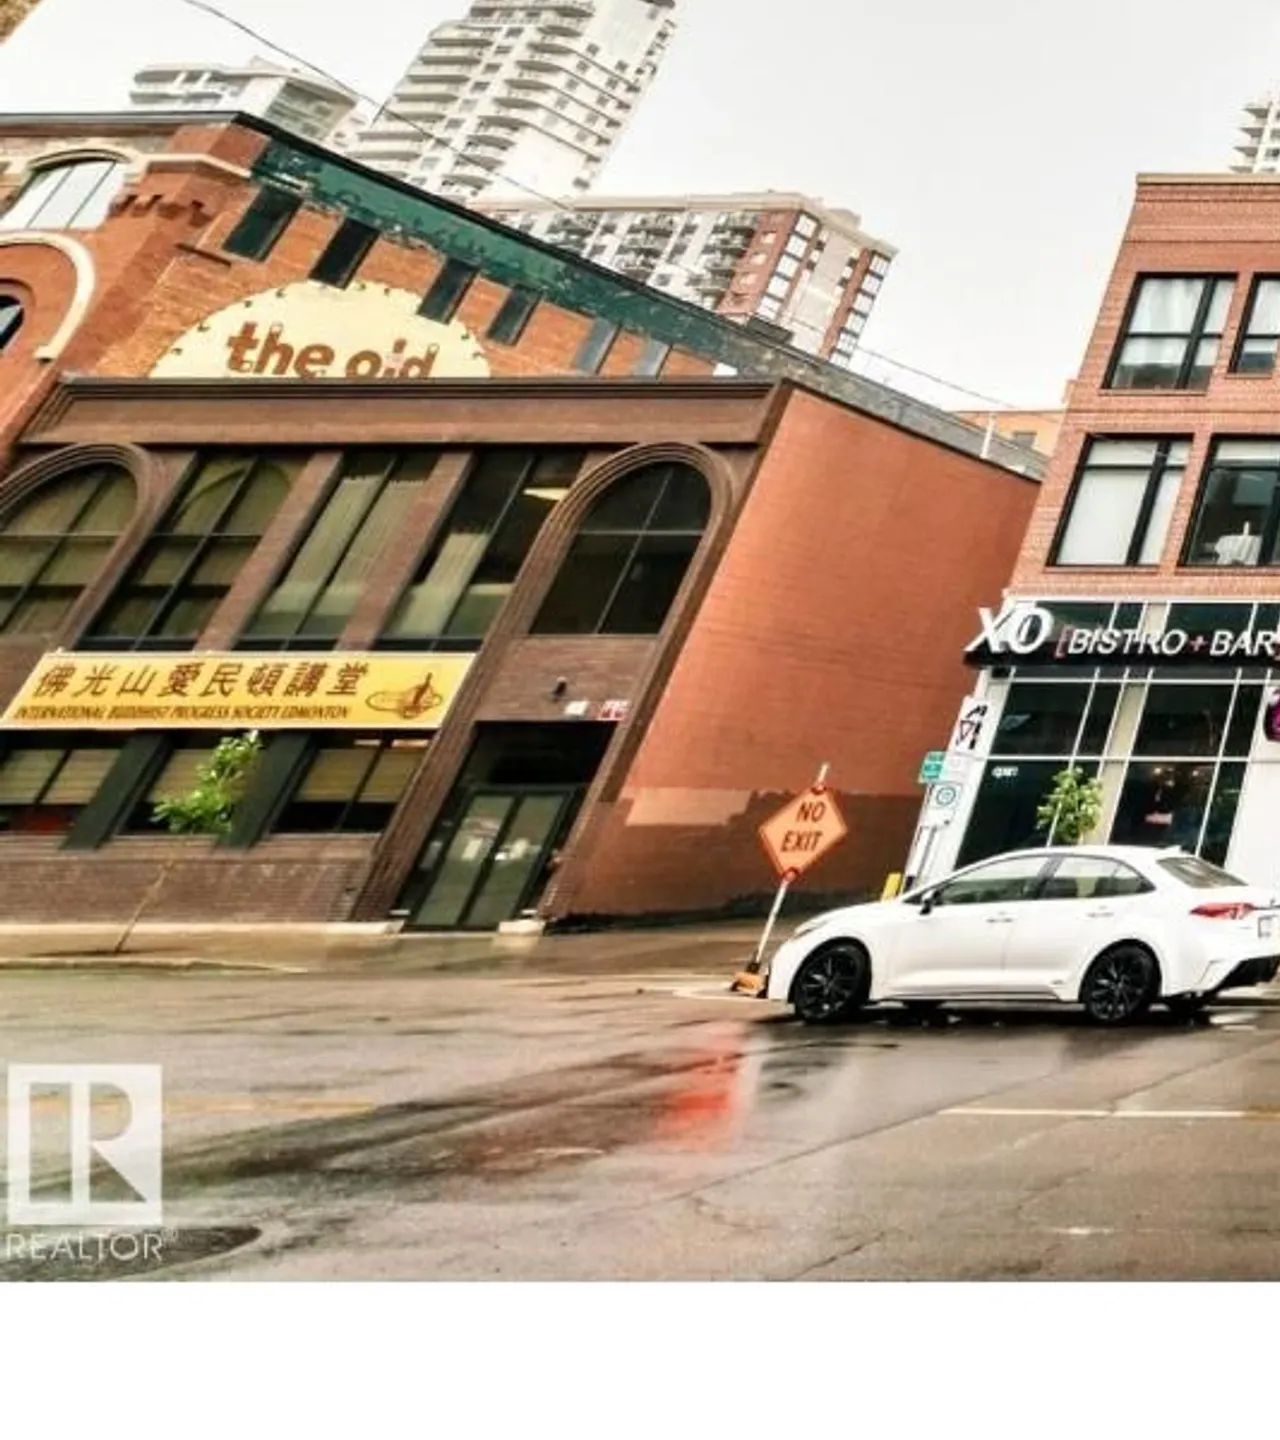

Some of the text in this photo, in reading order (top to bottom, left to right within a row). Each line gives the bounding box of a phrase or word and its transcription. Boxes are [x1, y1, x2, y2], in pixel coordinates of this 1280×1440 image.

[226, 322, 335, 378] the
[964, 607, 1054, 654] XO
[796, 801, 826, 823] NO
[780, 830, 824, 853] EXIT
